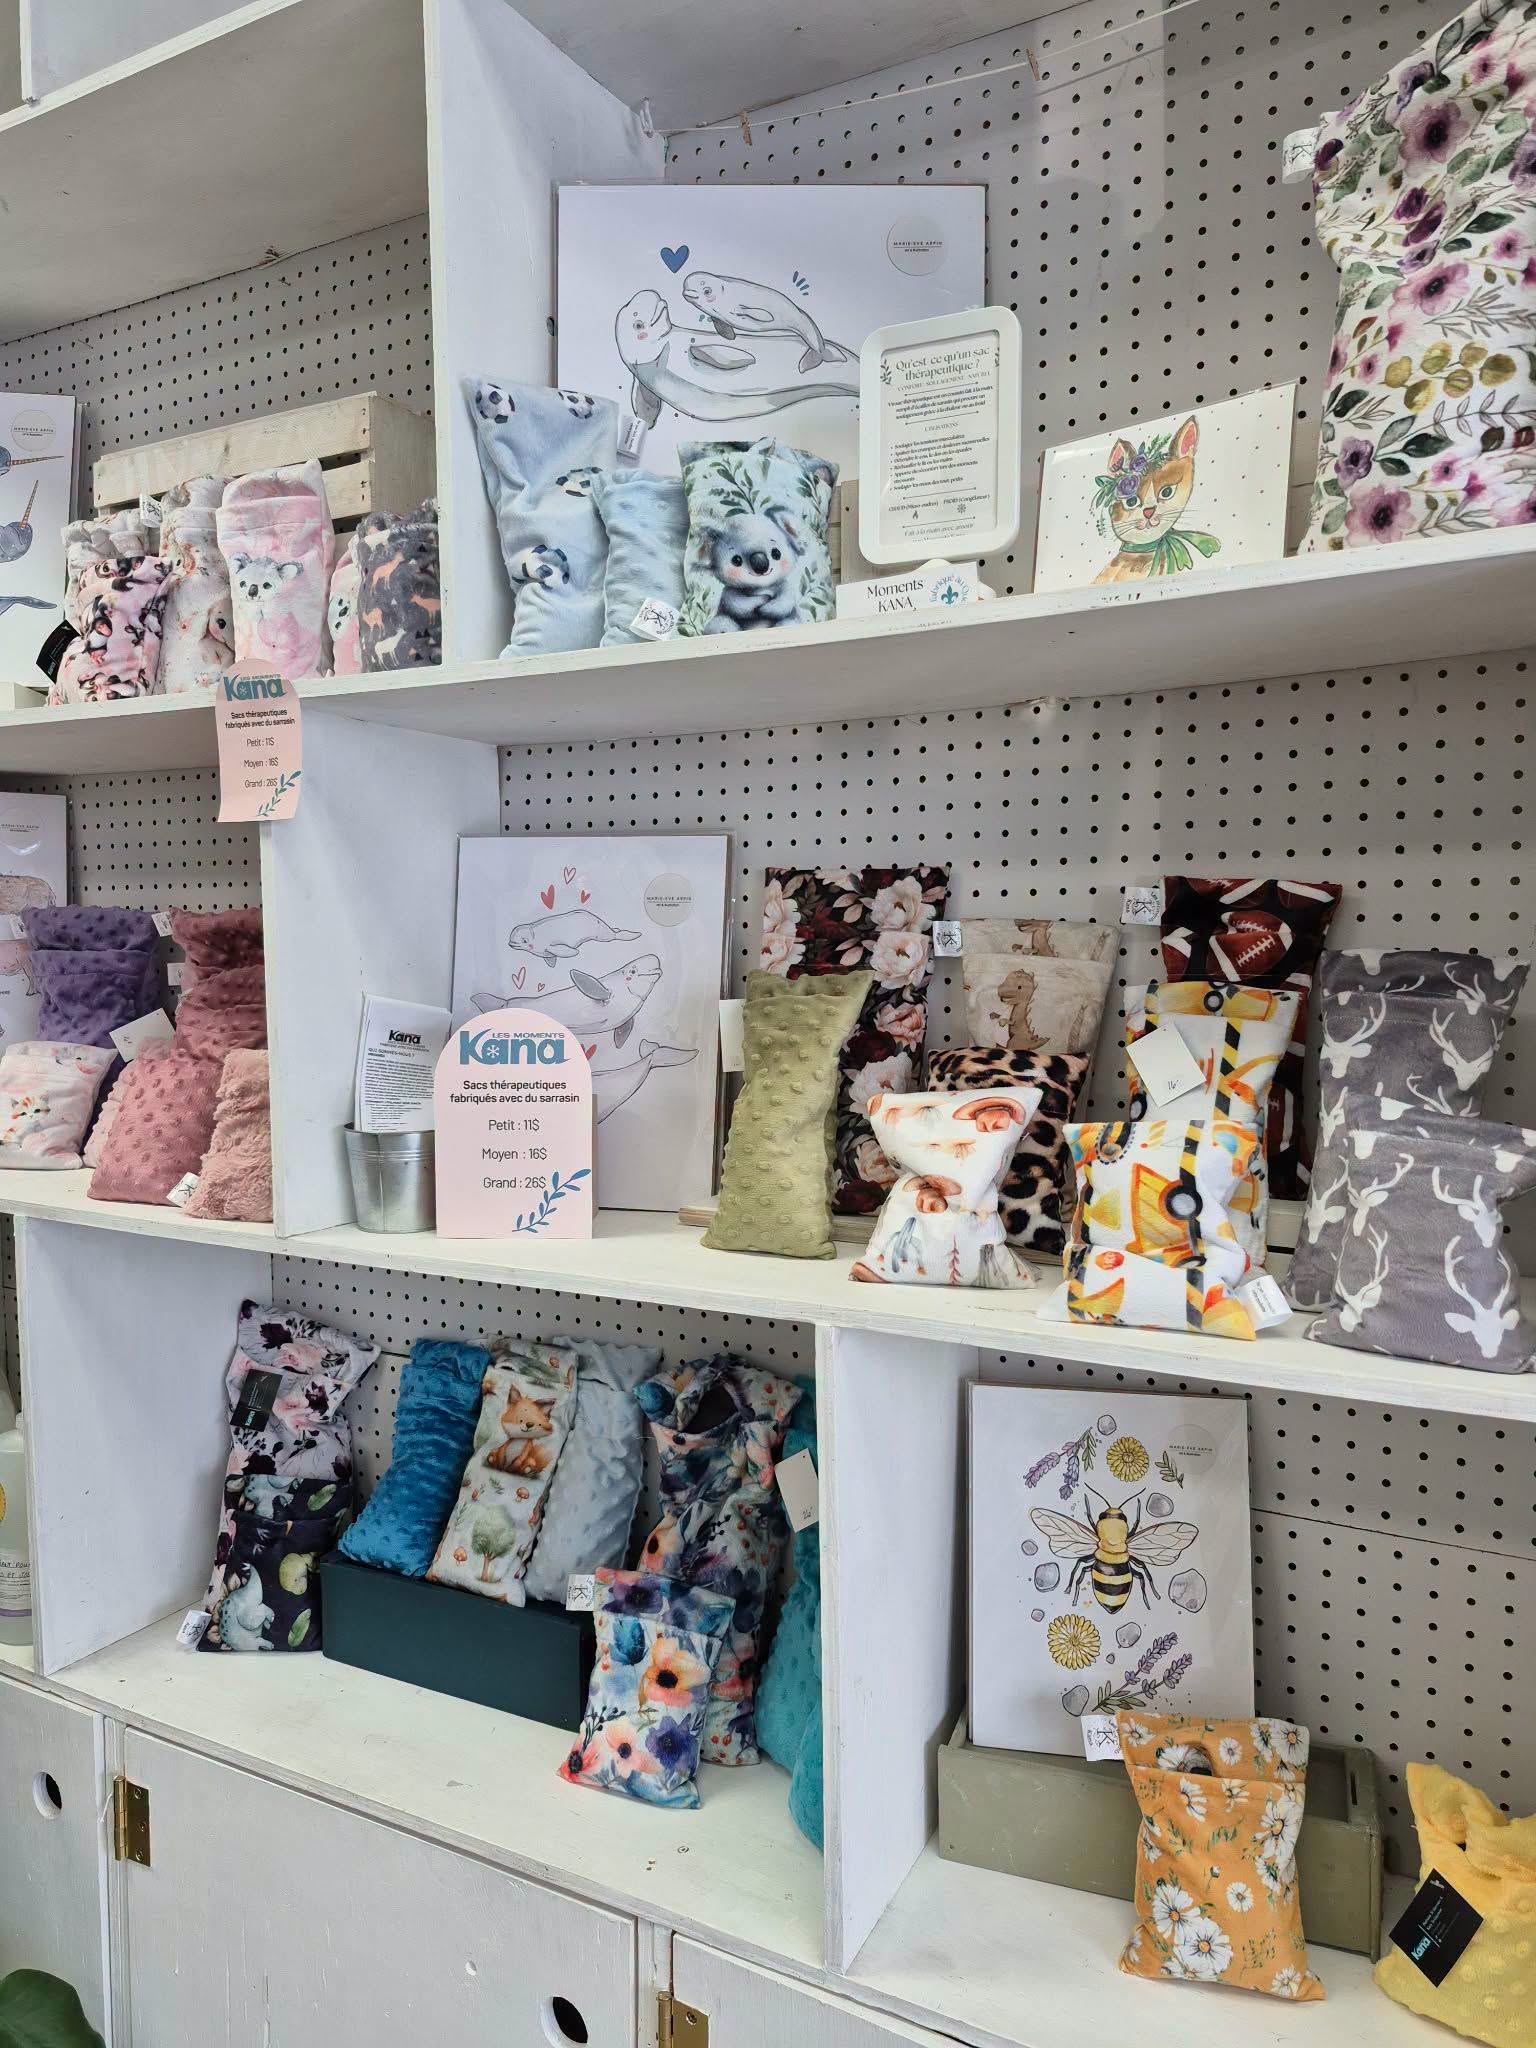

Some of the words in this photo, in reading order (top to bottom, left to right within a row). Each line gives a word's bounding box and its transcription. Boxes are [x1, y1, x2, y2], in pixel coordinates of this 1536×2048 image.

[930, 356, 941, 364] ce
[972, 347, 990, 357] sac
[867, 578, 924, 599] Moments
[878, 596, 914, 612] KANA
[224, 674, 288, 701] Kana
[246, 738, 261, 747] Petit
[244, 760, 263, 769] Moyen
[244, 779, 262, 788] Grand
[388, 1030, 421, 1044] Kana
[459, 1029, 571, 1065] Kana
[463, 1080, 488, 1090] Sacs
[490, 1080, 566, 1092] thérapeutiques
[450, 1093, 497, 1105] fabriqués
[525, 1093, 538, 1103] du
[539, 1093, 580, 1103] sarrasin
[489, 1120, 515, 1131] Petit
[524, 1119, 540, 1132] 11$
[482, 1149, 518, 1162] Moyen
[529, 1148, 547, 1161] 16$
[483, 1177, 517, 1189] Grand
[524, 1177, 546, 1190] 26$
[1411, 1936, 1431, 1960] Kana
